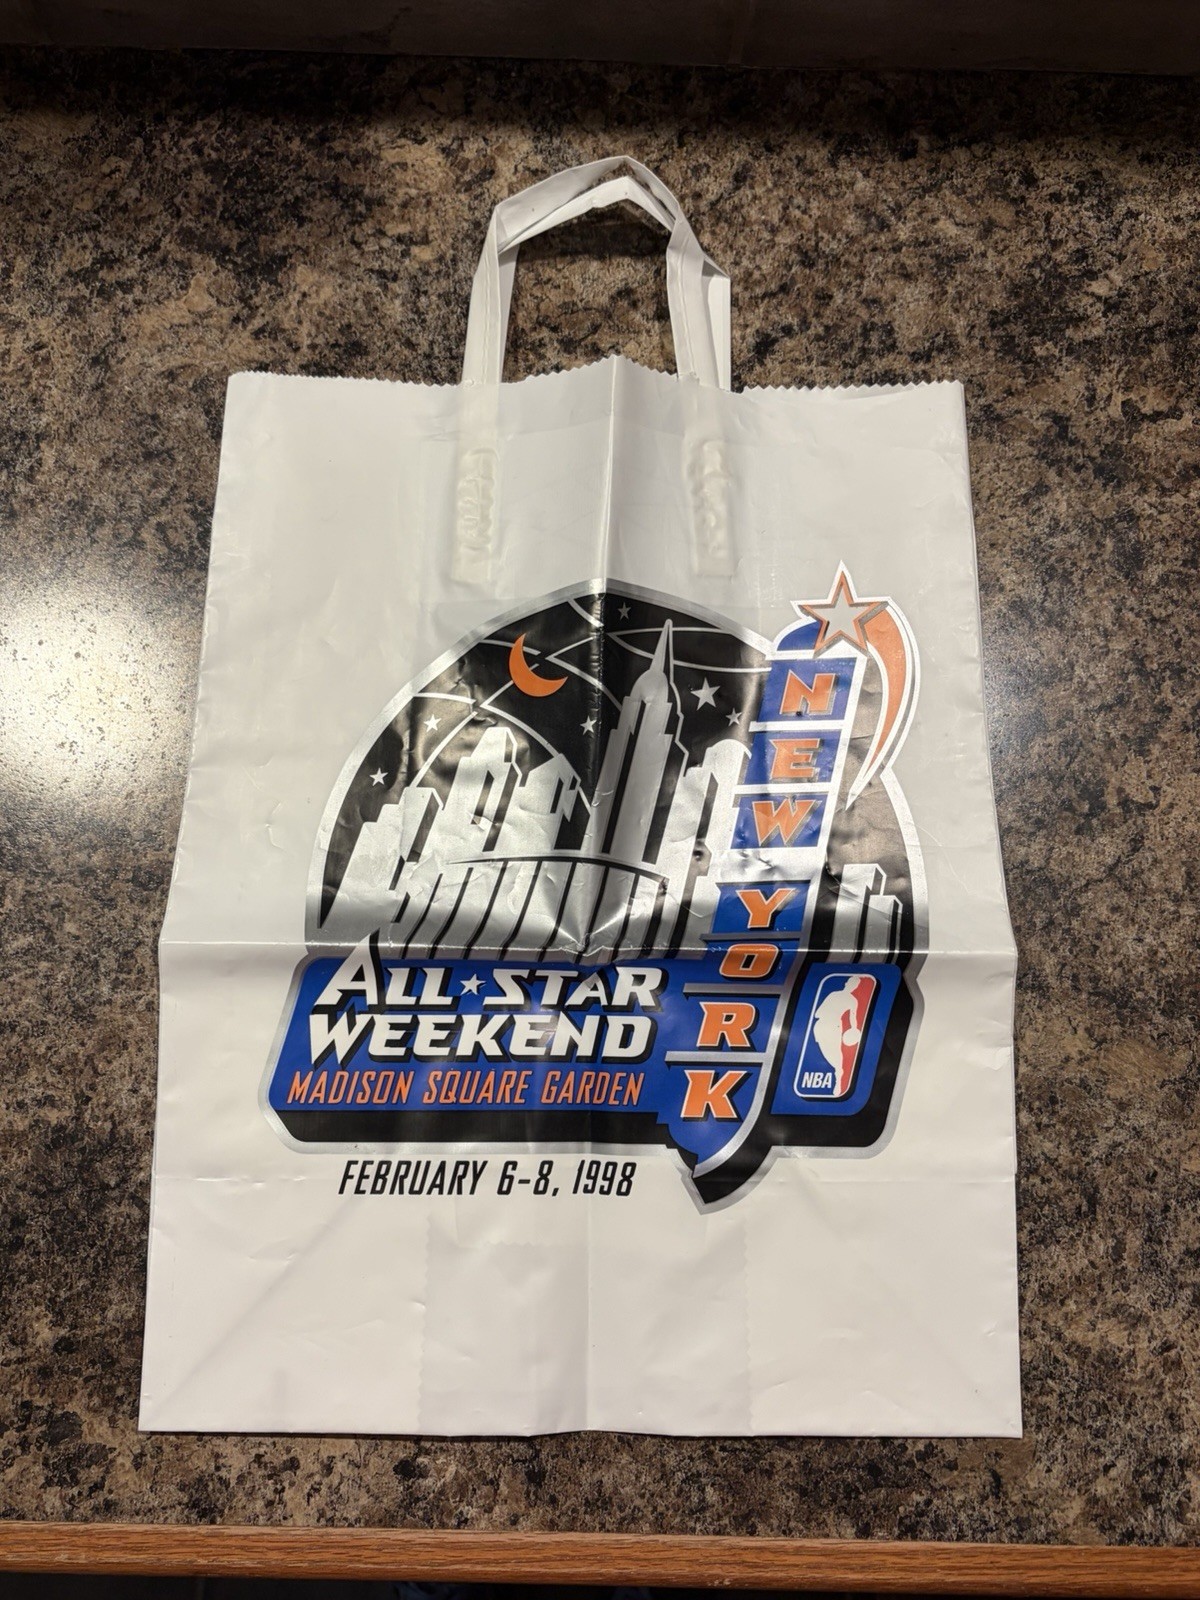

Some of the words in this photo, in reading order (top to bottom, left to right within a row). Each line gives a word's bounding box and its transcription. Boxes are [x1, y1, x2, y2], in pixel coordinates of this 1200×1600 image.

[752, 669, 835, 846] NEW
[314, 930, 455, 1008] ALL
[482, 966, 663, 1008] STAR
[681, 888, 796, 1118] YORK
[309, 1014, 653, 1066] WEEKEND
[287, 1070, 414, 1104] MADISON
[423, 1070, 532, 1104] SQUARE
[541, 1070, 645, 1106] GARDEN
[802, 1072, 832, 1088] NBA
[338, 1160, 487, 1195] FEBRUARY
[497, 1160, 560, 1197] 6-8,
[572, 1160, 637, 1197] 1998
